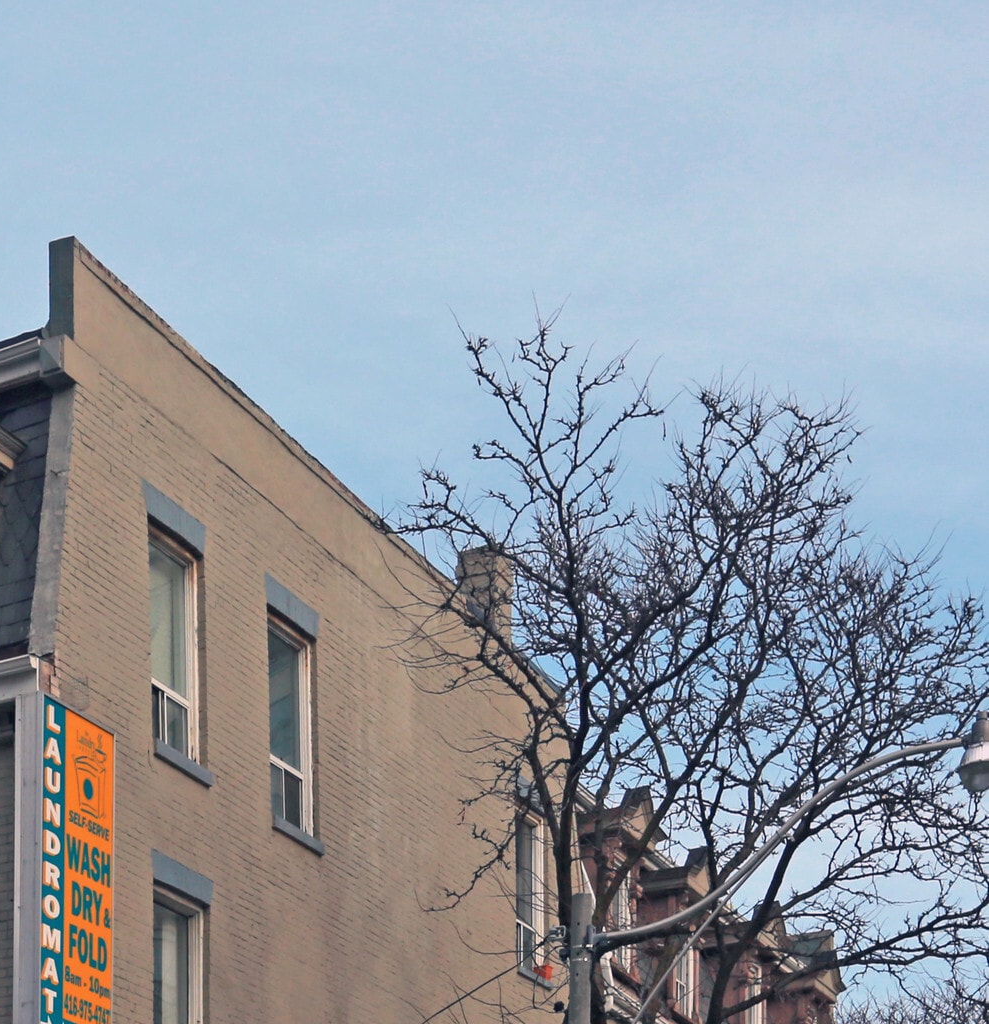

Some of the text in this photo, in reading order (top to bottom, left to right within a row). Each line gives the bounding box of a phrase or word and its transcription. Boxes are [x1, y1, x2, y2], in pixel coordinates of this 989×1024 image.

[69, 809, 110, 841] SELF-SERVE
[42, 703, 61, 1015] LAUNDROMAT
[66, 833, 111, 888] WASH
[71, 880, 111, 929] DRY &
[69, 923, 108, 972] FOLD
[64, 965, 82, 987] 8am
[89, 975, 111, 999] 10pm
